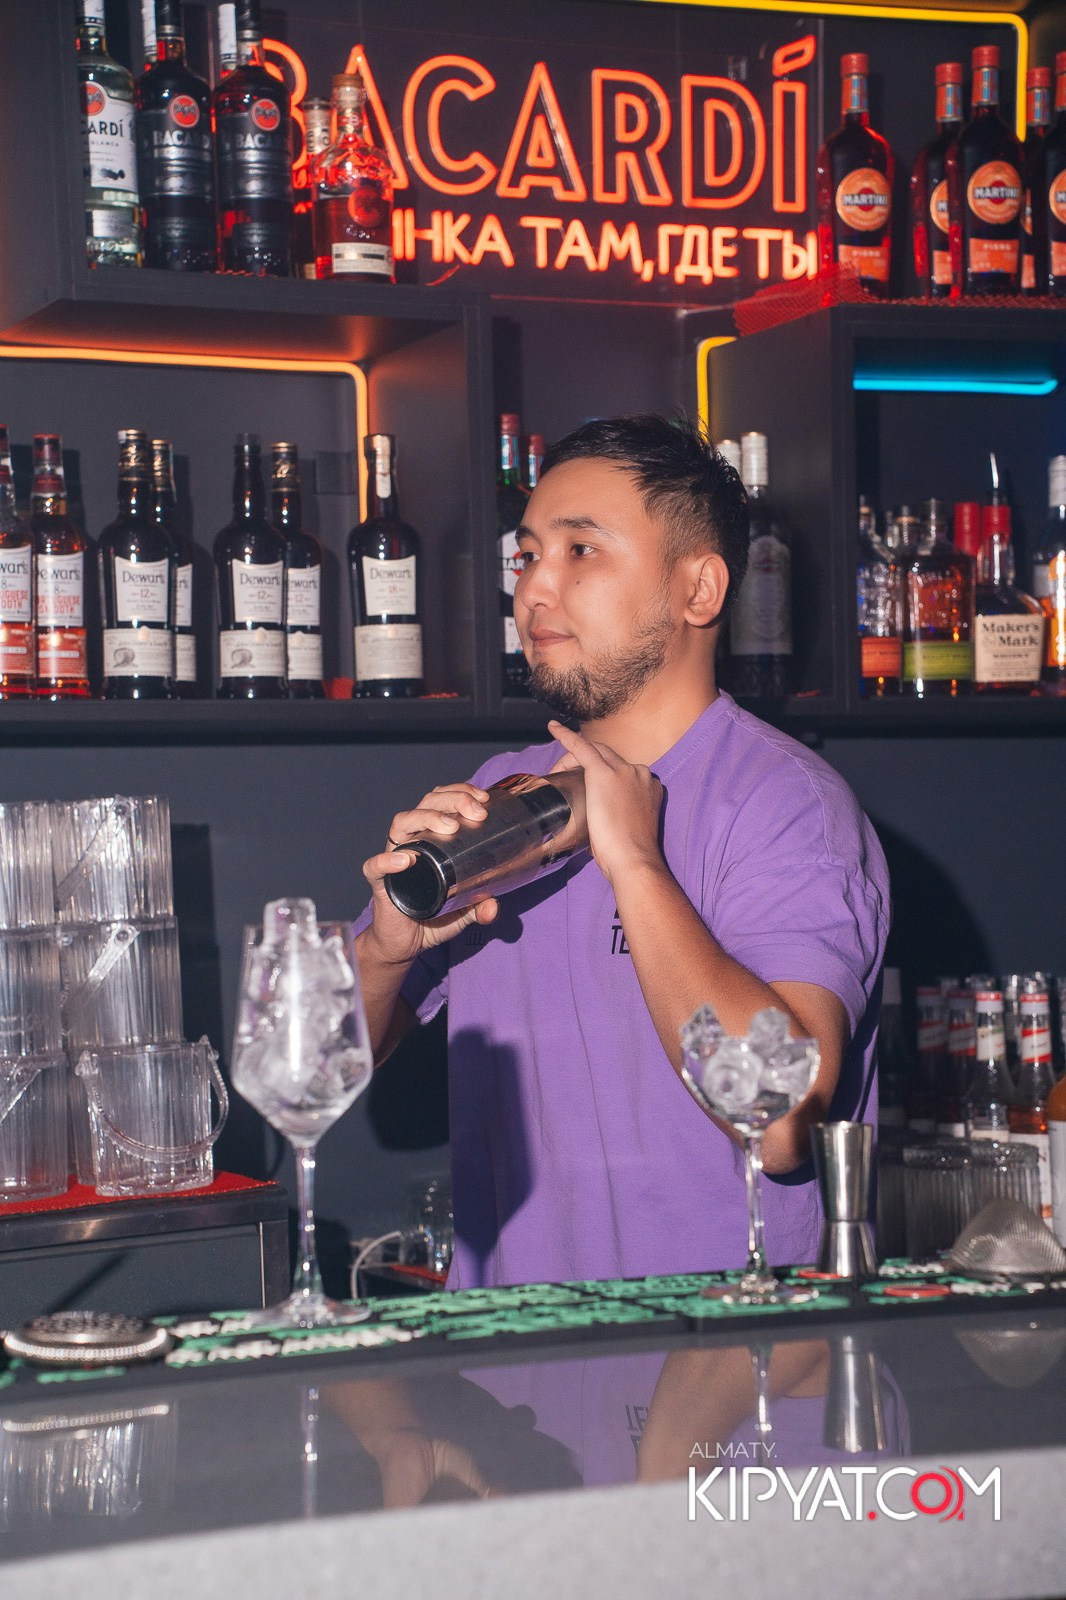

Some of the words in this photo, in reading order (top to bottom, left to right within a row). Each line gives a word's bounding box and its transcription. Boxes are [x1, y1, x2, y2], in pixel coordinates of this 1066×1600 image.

[87, 118, 124, 137] ARDÍ
[974, 187, 1019, 199] MARTINI
[843, 194, 888, 206] MARTINI
[657, 223, 740, 284] ГДЕ
[741, 227, 818, 281] ТЫ
[140, 589, 150, 599] 12
[257, 591, 267, 600] 12
[983, 621, 1040, 633] Maker's
[999, 634, 1040, 646] Mark
